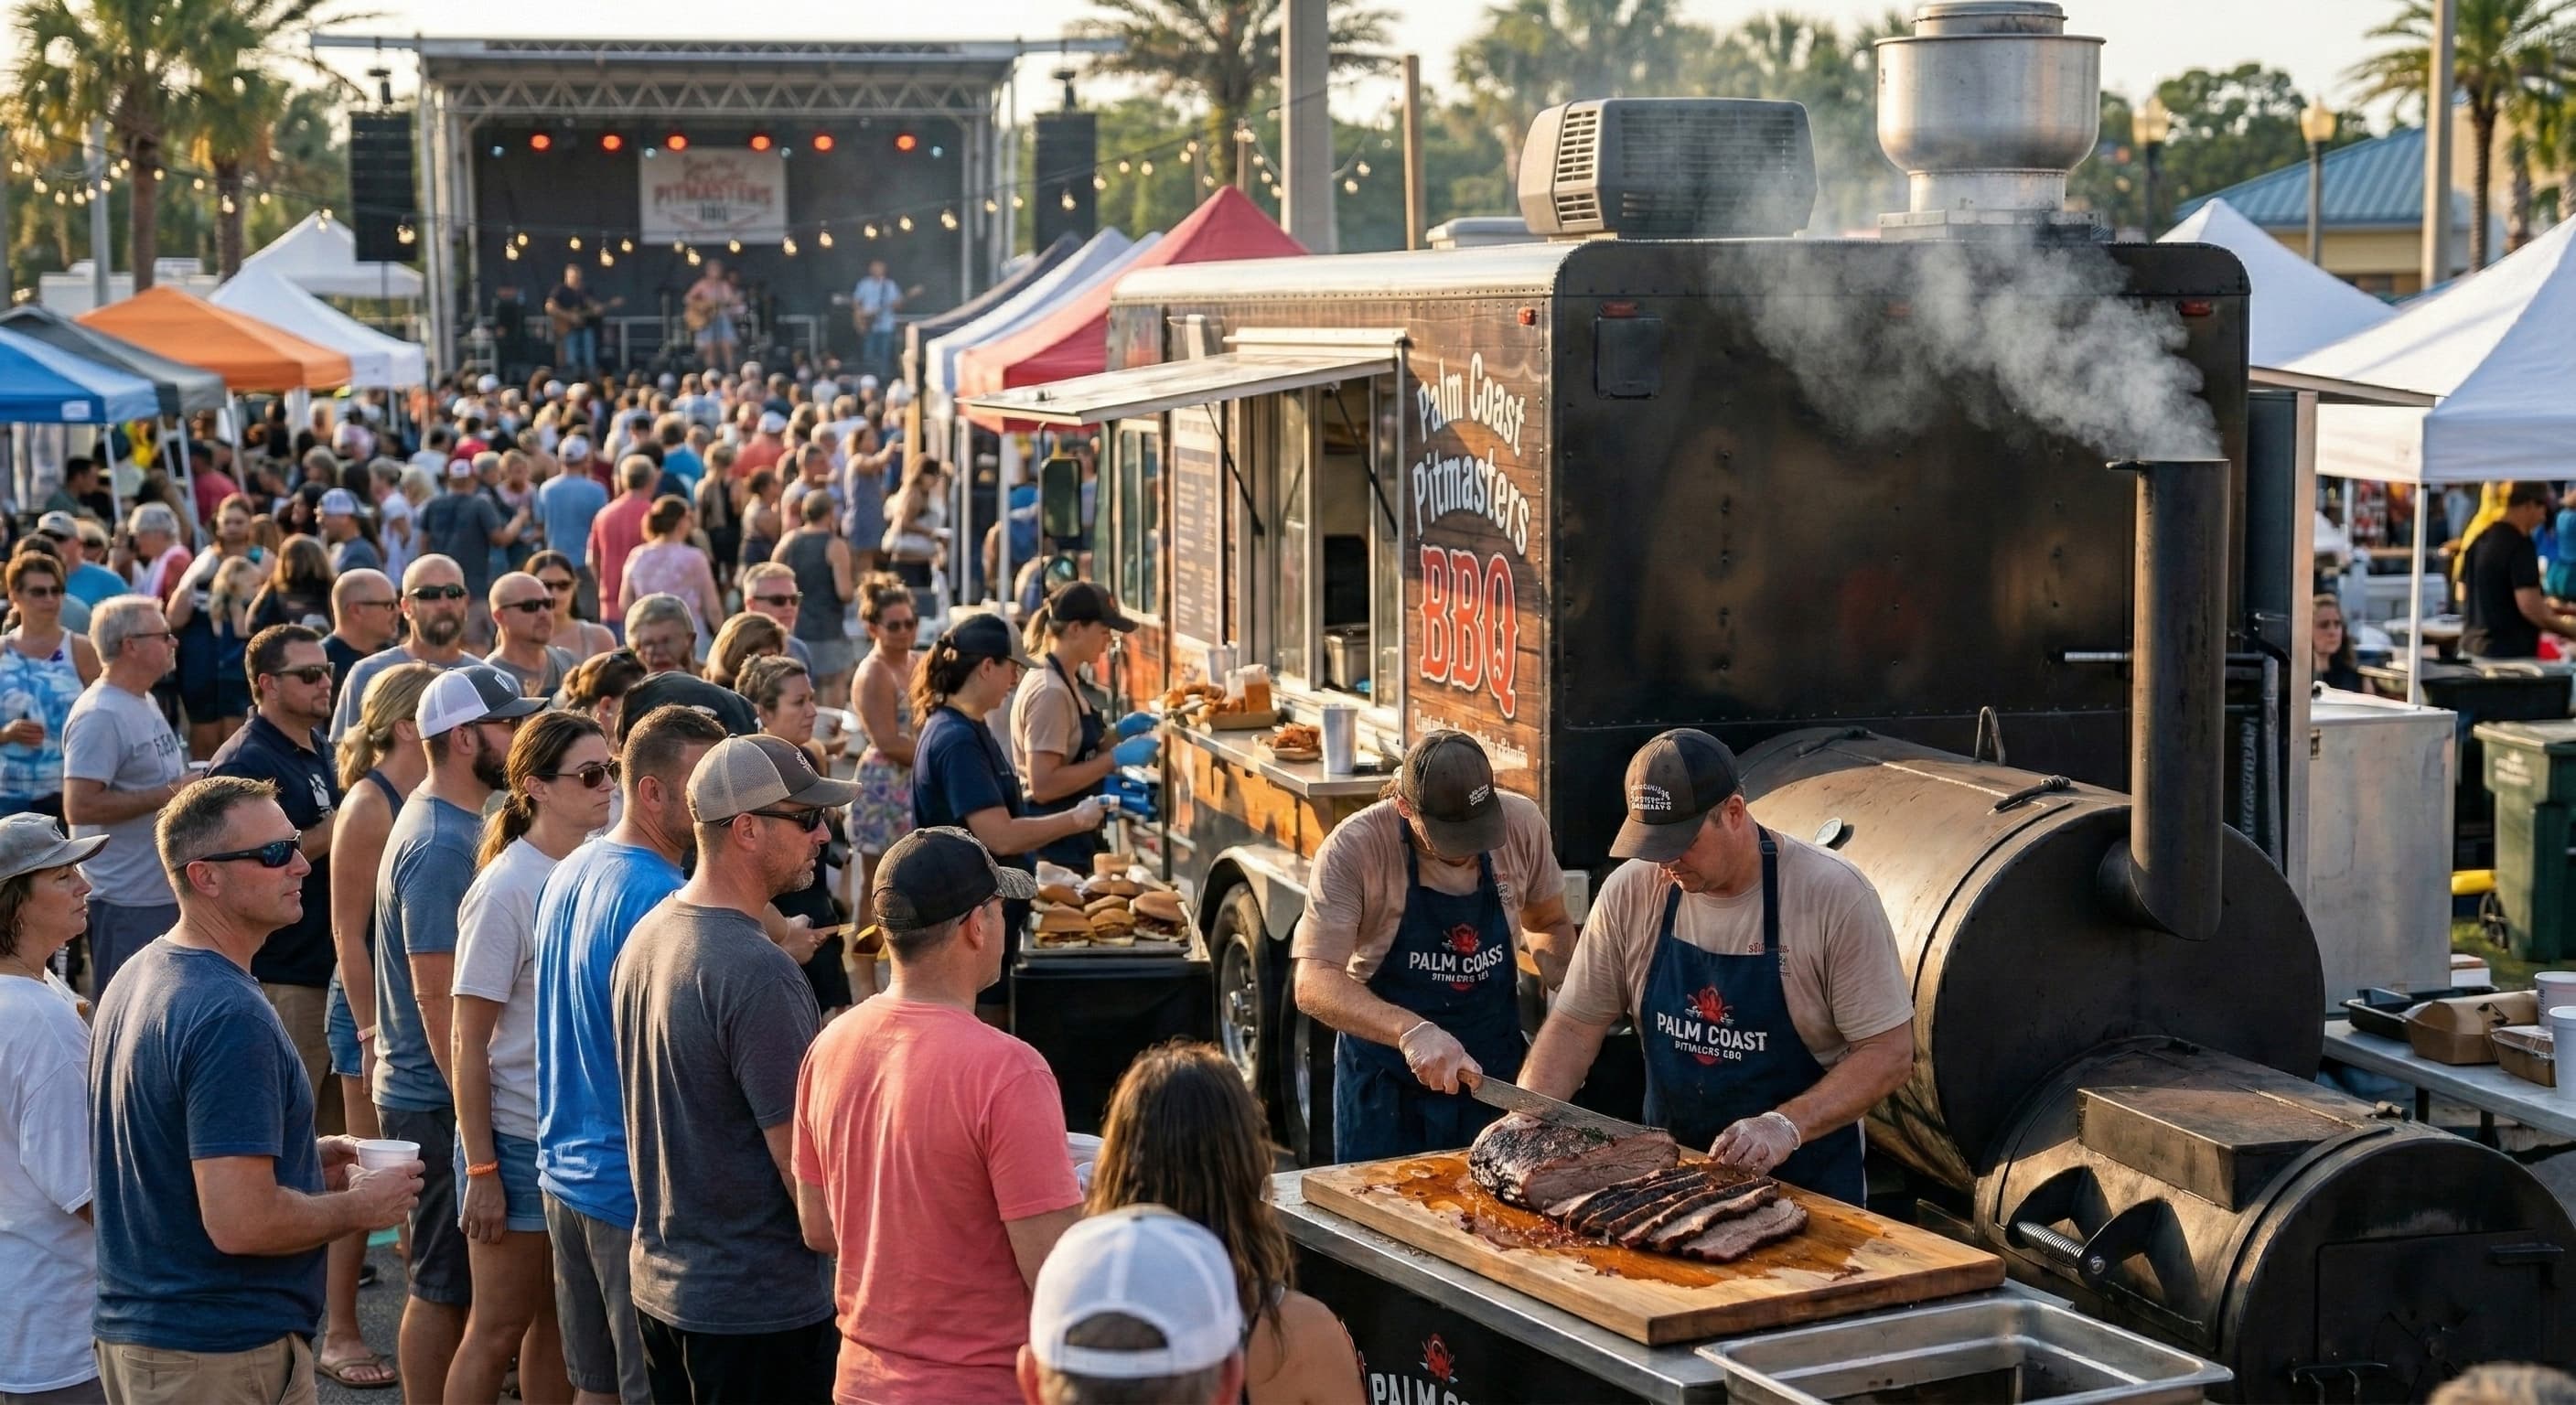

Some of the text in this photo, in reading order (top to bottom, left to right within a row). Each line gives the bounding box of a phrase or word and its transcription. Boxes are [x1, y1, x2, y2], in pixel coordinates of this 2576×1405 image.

[1416, 351, 1526, 457] Palm Coast
[1411, 447, 1530, 556] Pitmasters
[1419, 544, 1519, 719] BBQ
[1409, 951, 1457, 972] PALM
[1657, 1011, 1768, 1052] PALM COAST
